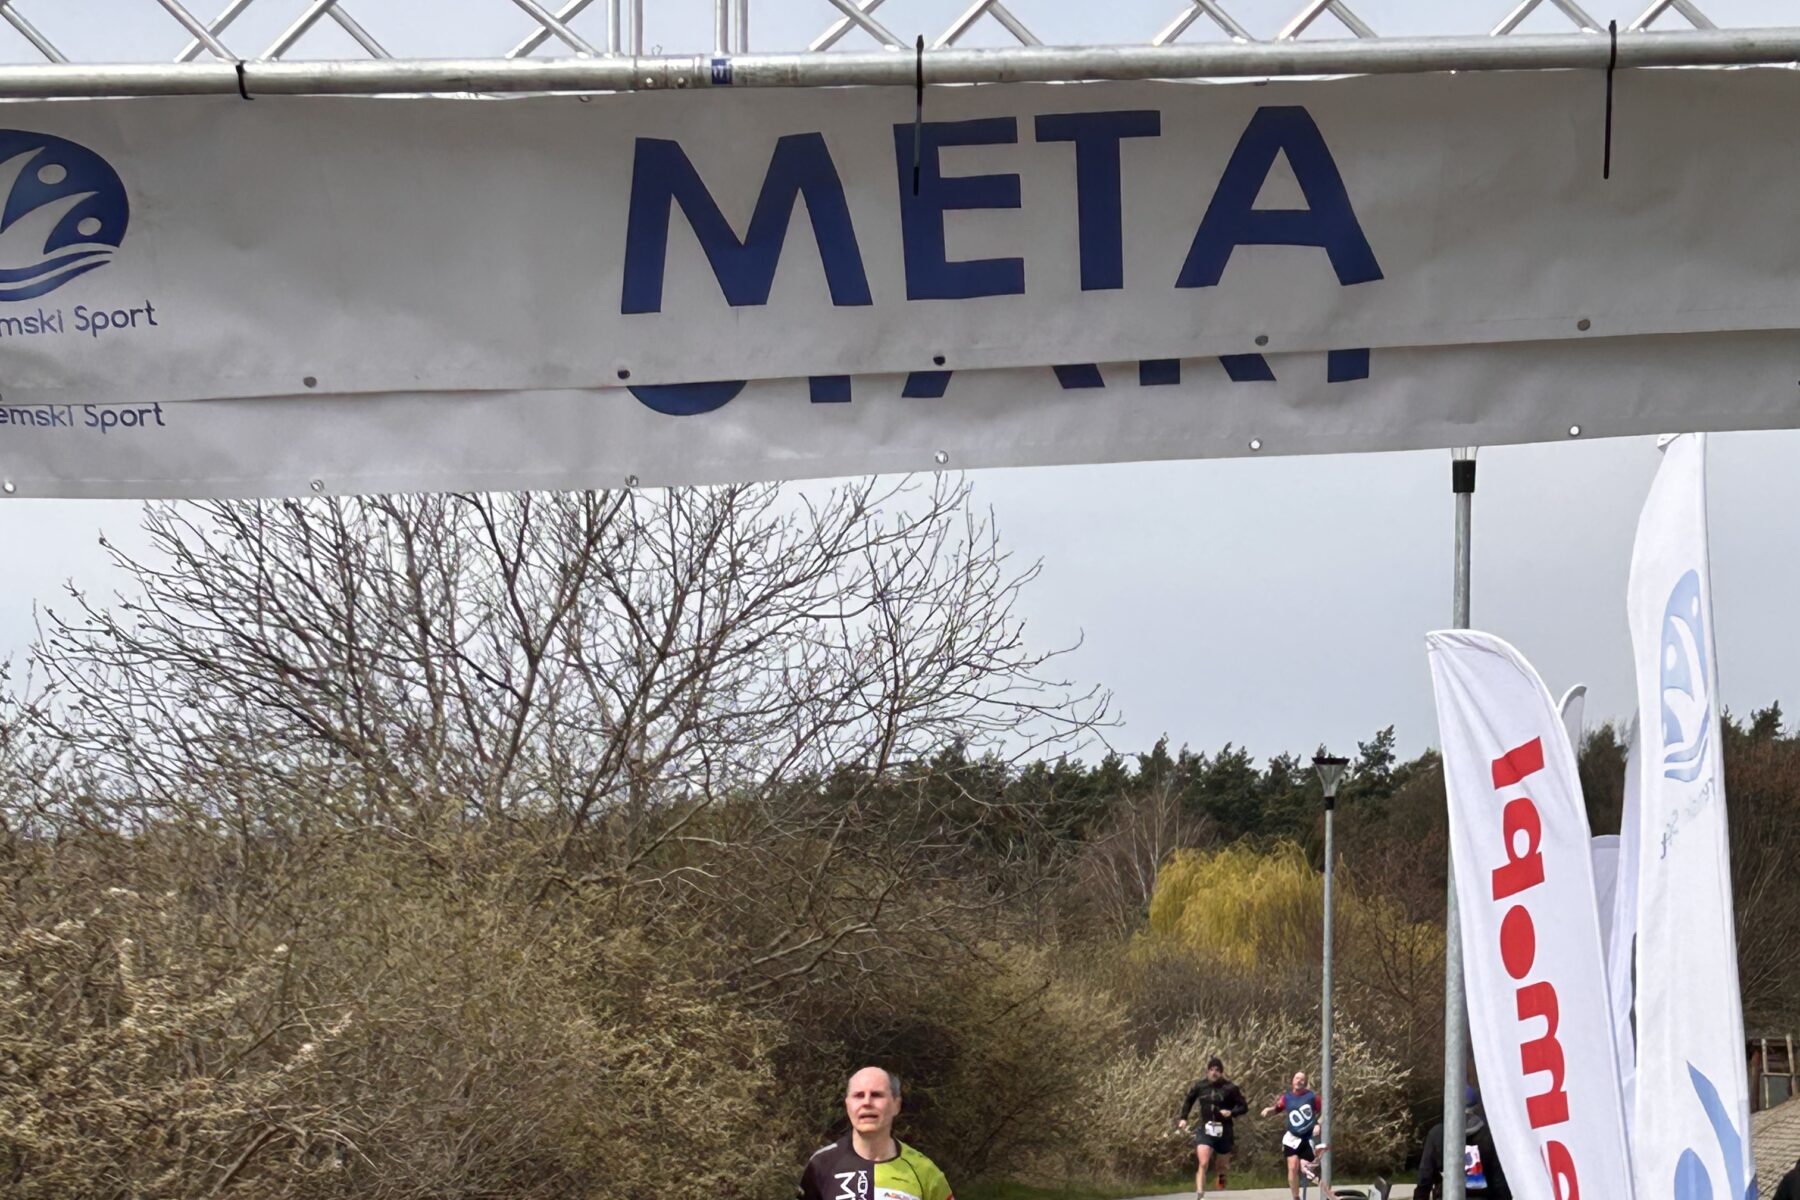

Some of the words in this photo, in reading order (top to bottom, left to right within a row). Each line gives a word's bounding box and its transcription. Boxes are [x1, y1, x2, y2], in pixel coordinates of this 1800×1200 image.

[621, 105, 1384, 315] META
[74, 299, 158, 338] Sport
[83, 402, 166, 435] Sport
